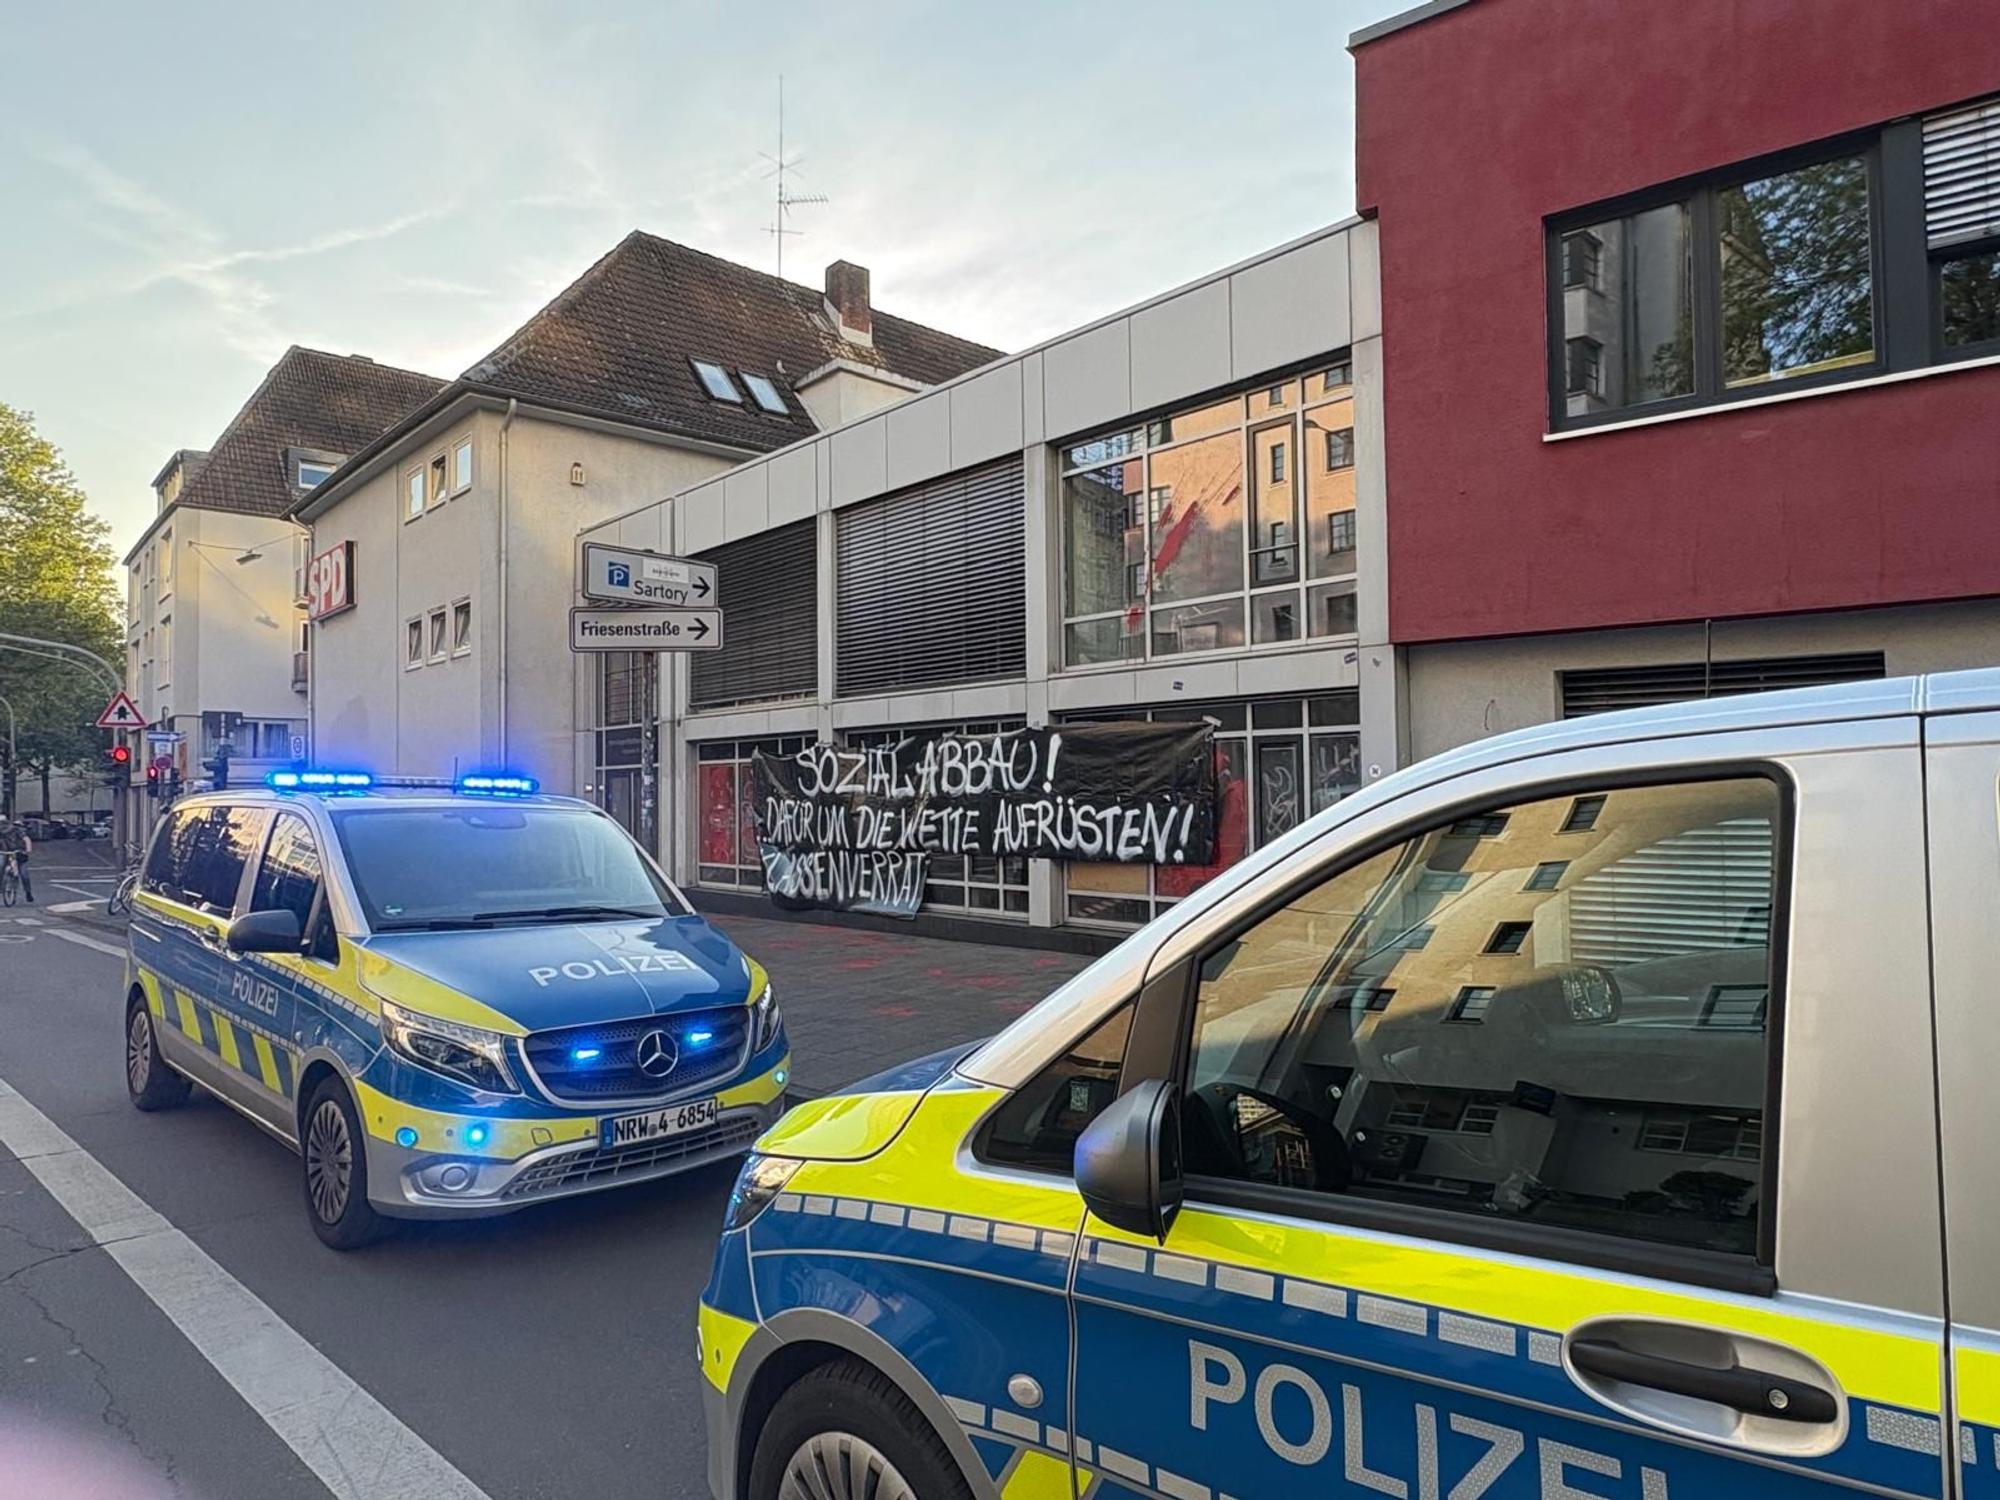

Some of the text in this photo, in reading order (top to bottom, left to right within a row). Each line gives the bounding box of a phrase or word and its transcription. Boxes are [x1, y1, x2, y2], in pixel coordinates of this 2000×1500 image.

[309, 548, 345, 618] SPD
[633, 580, 689, 605] Sartory
[581, 620, 680, 637] Friesenstraße
[818, 804, 850, 850] UM
[856, 805, 895, 849] DIE
[894, 806, 980, 855] WETTE
[528, 954, 698, 987] POLIZEI
[231, 972, 279, 1017] POLIZEI
[614, 1101, 714, 1143] NRW 4-6854
